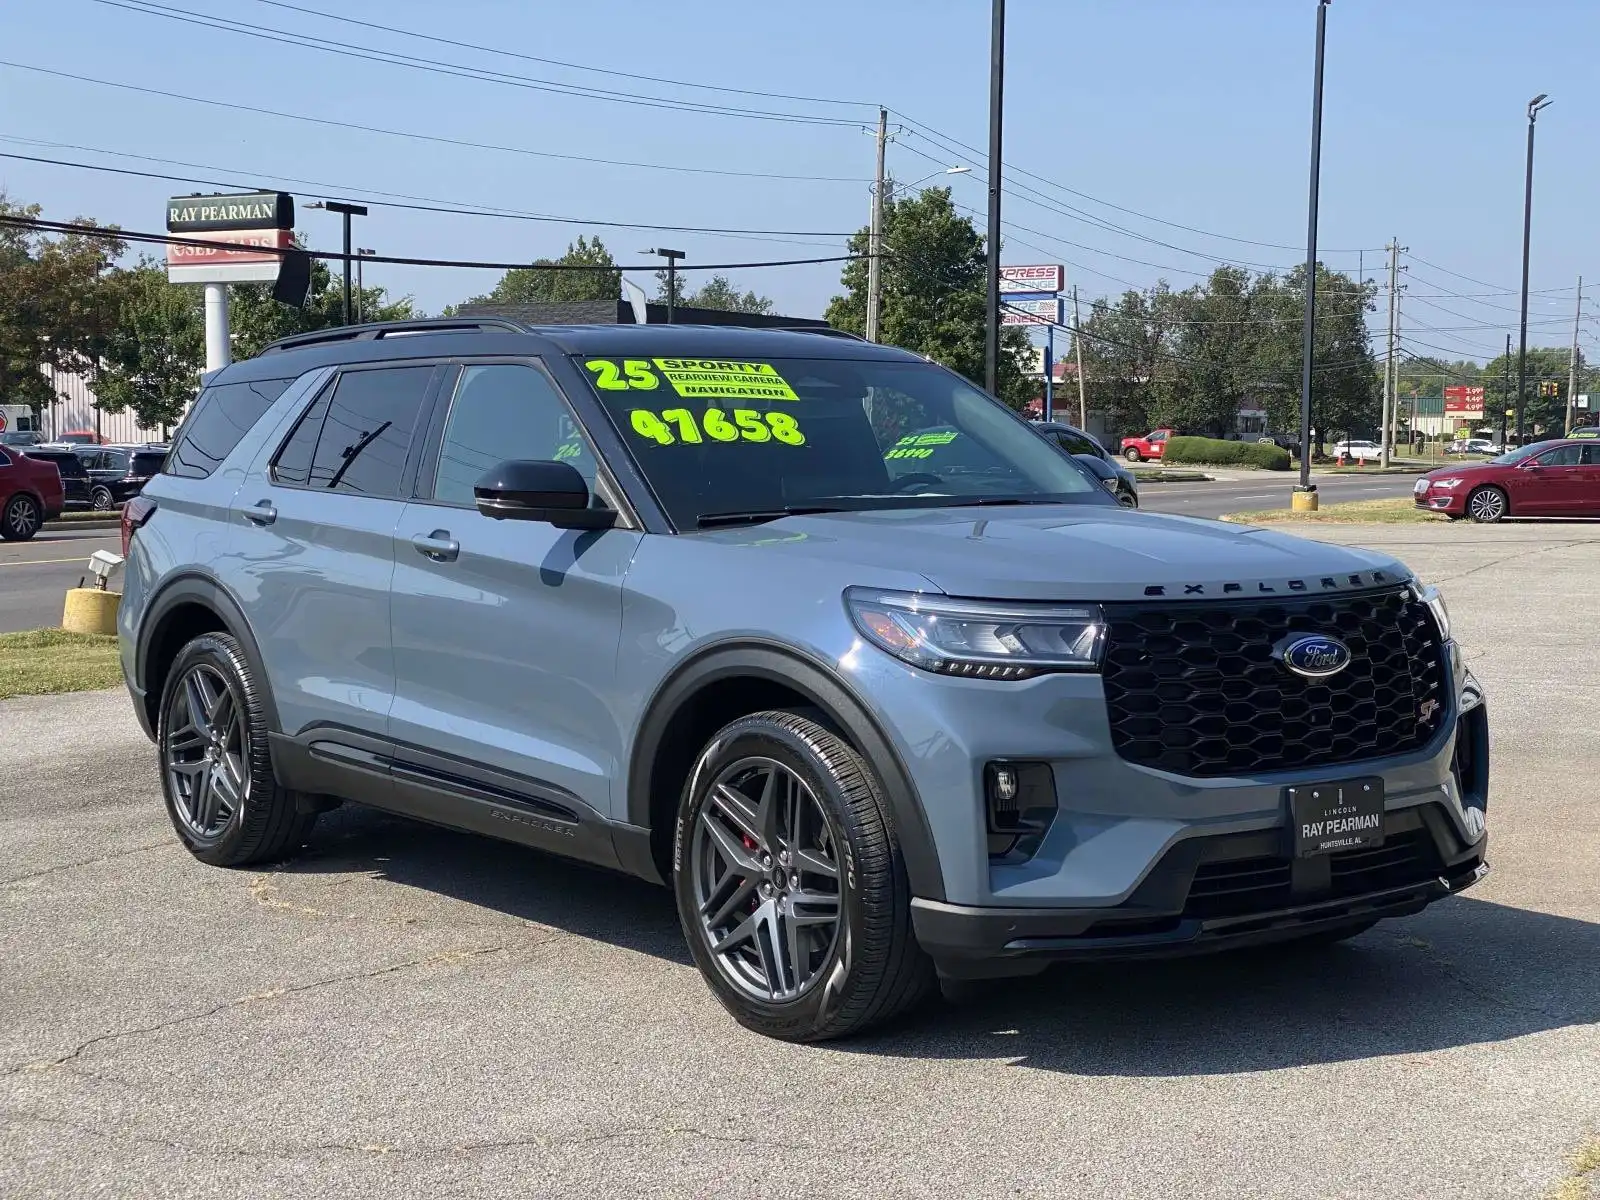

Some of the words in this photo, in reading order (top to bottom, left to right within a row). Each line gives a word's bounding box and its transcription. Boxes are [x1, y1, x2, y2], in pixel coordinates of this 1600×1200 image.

[170, 207, 200, 222] RAY
[201, 203, 274, 221] PEARMAN
[585, 360, 660, 390] 25
[662, 360, 764, 374] SPORTY
[668, 372, 732, 382] REARVIEW
[733, 374, 785, 386] CAMERA
[684, 385, 785, 397] NAVIGATION
[630, 408, 806, 445] 47658
[1143, 571, 1386, 596] EXPLORER
[1304, 644, 1339, 667] Ford
[1324, 805, 1357, 817] LINCOLN
[1302, 821, 1325, 839] RAY
[1326, 813, 1379, 835] PEARMAN
